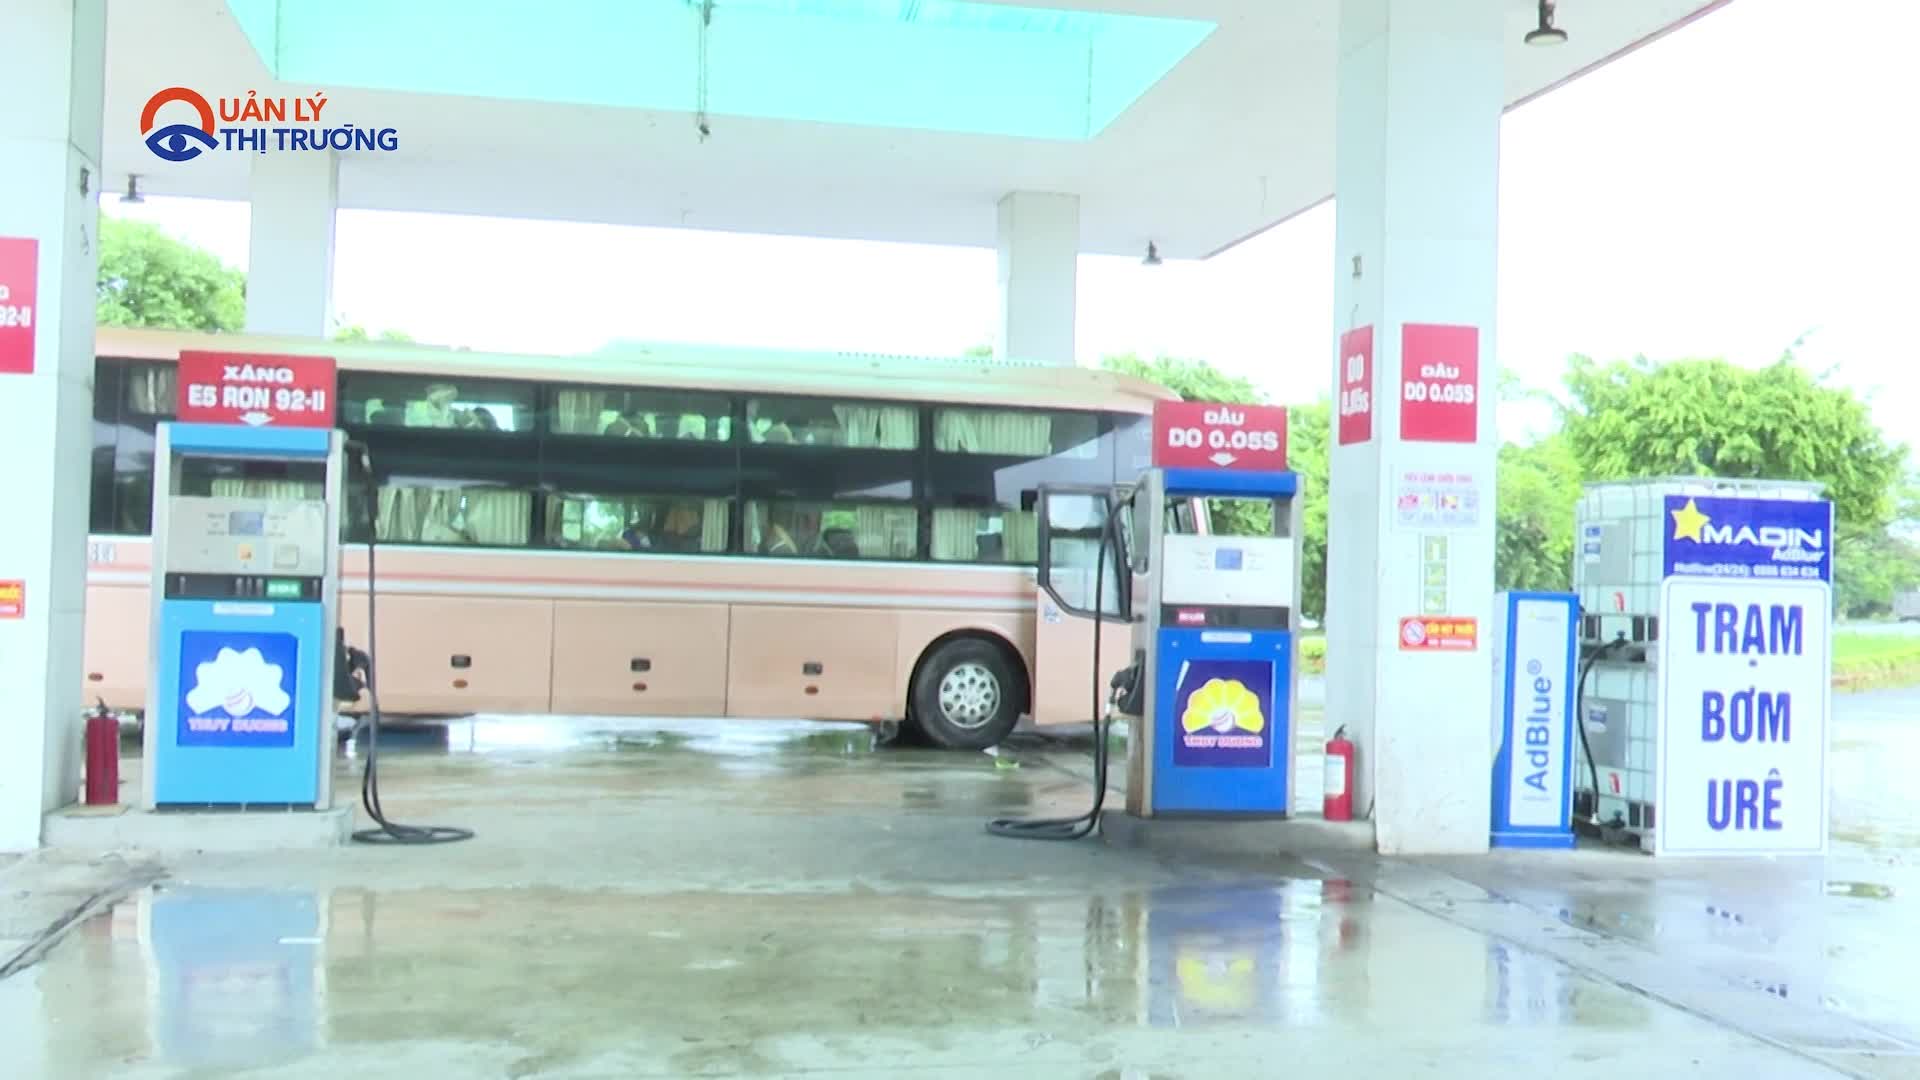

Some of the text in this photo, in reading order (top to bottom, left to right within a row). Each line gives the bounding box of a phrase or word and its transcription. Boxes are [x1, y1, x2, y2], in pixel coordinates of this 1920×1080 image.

[188, 383, 326, 412] E5 RON 92-II
[1404, 381, 1474, 404] DO 0.05S
[1168, 427, 1279, 451] DO 0.05S
[1691, 601, 1803, 668] TRẠM
[1701, 685, 1791, 744] BƠM
[1707, 767, 1784, 832] URÊ
